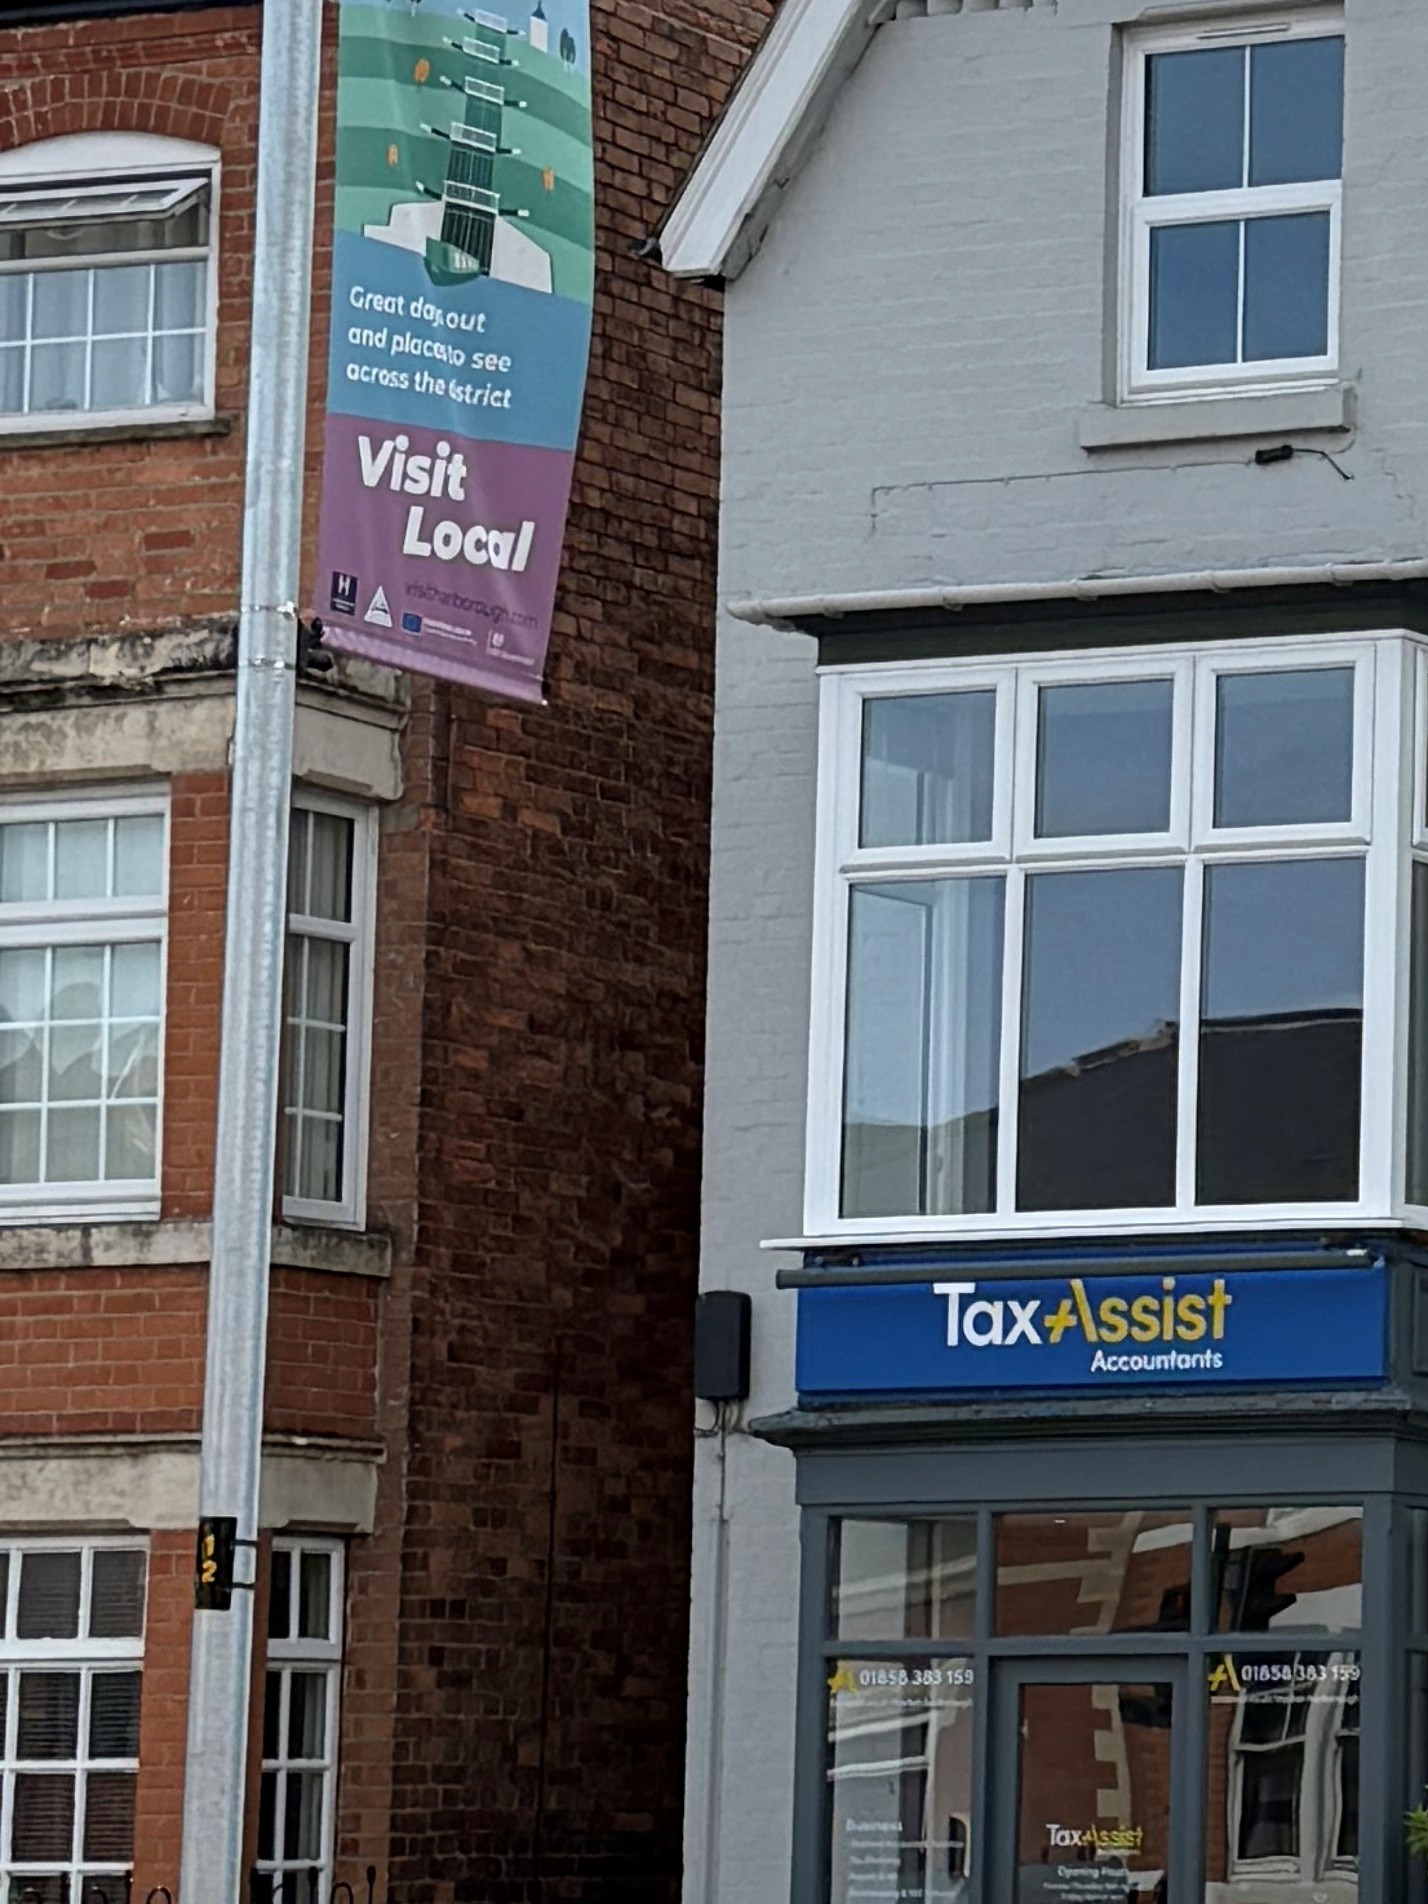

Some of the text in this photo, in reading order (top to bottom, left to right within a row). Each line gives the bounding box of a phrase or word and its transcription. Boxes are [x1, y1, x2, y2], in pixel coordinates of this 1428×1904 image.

[350, 285, 404, 316] Great
[446, 312, 487, 334] out
[348, 326, 388, 349] and
[471, 352, 512, 372] see
[346, 362, 512, 409] across the istrict
[358, 434, 467, 501] Visit
[403, 505, 535, 572] Local
[1091, 1349, 1223, 1373] Accountants
[859, 1669, 908, 1685] 01858
[1241, 1664, 1292, 1681] 01858
